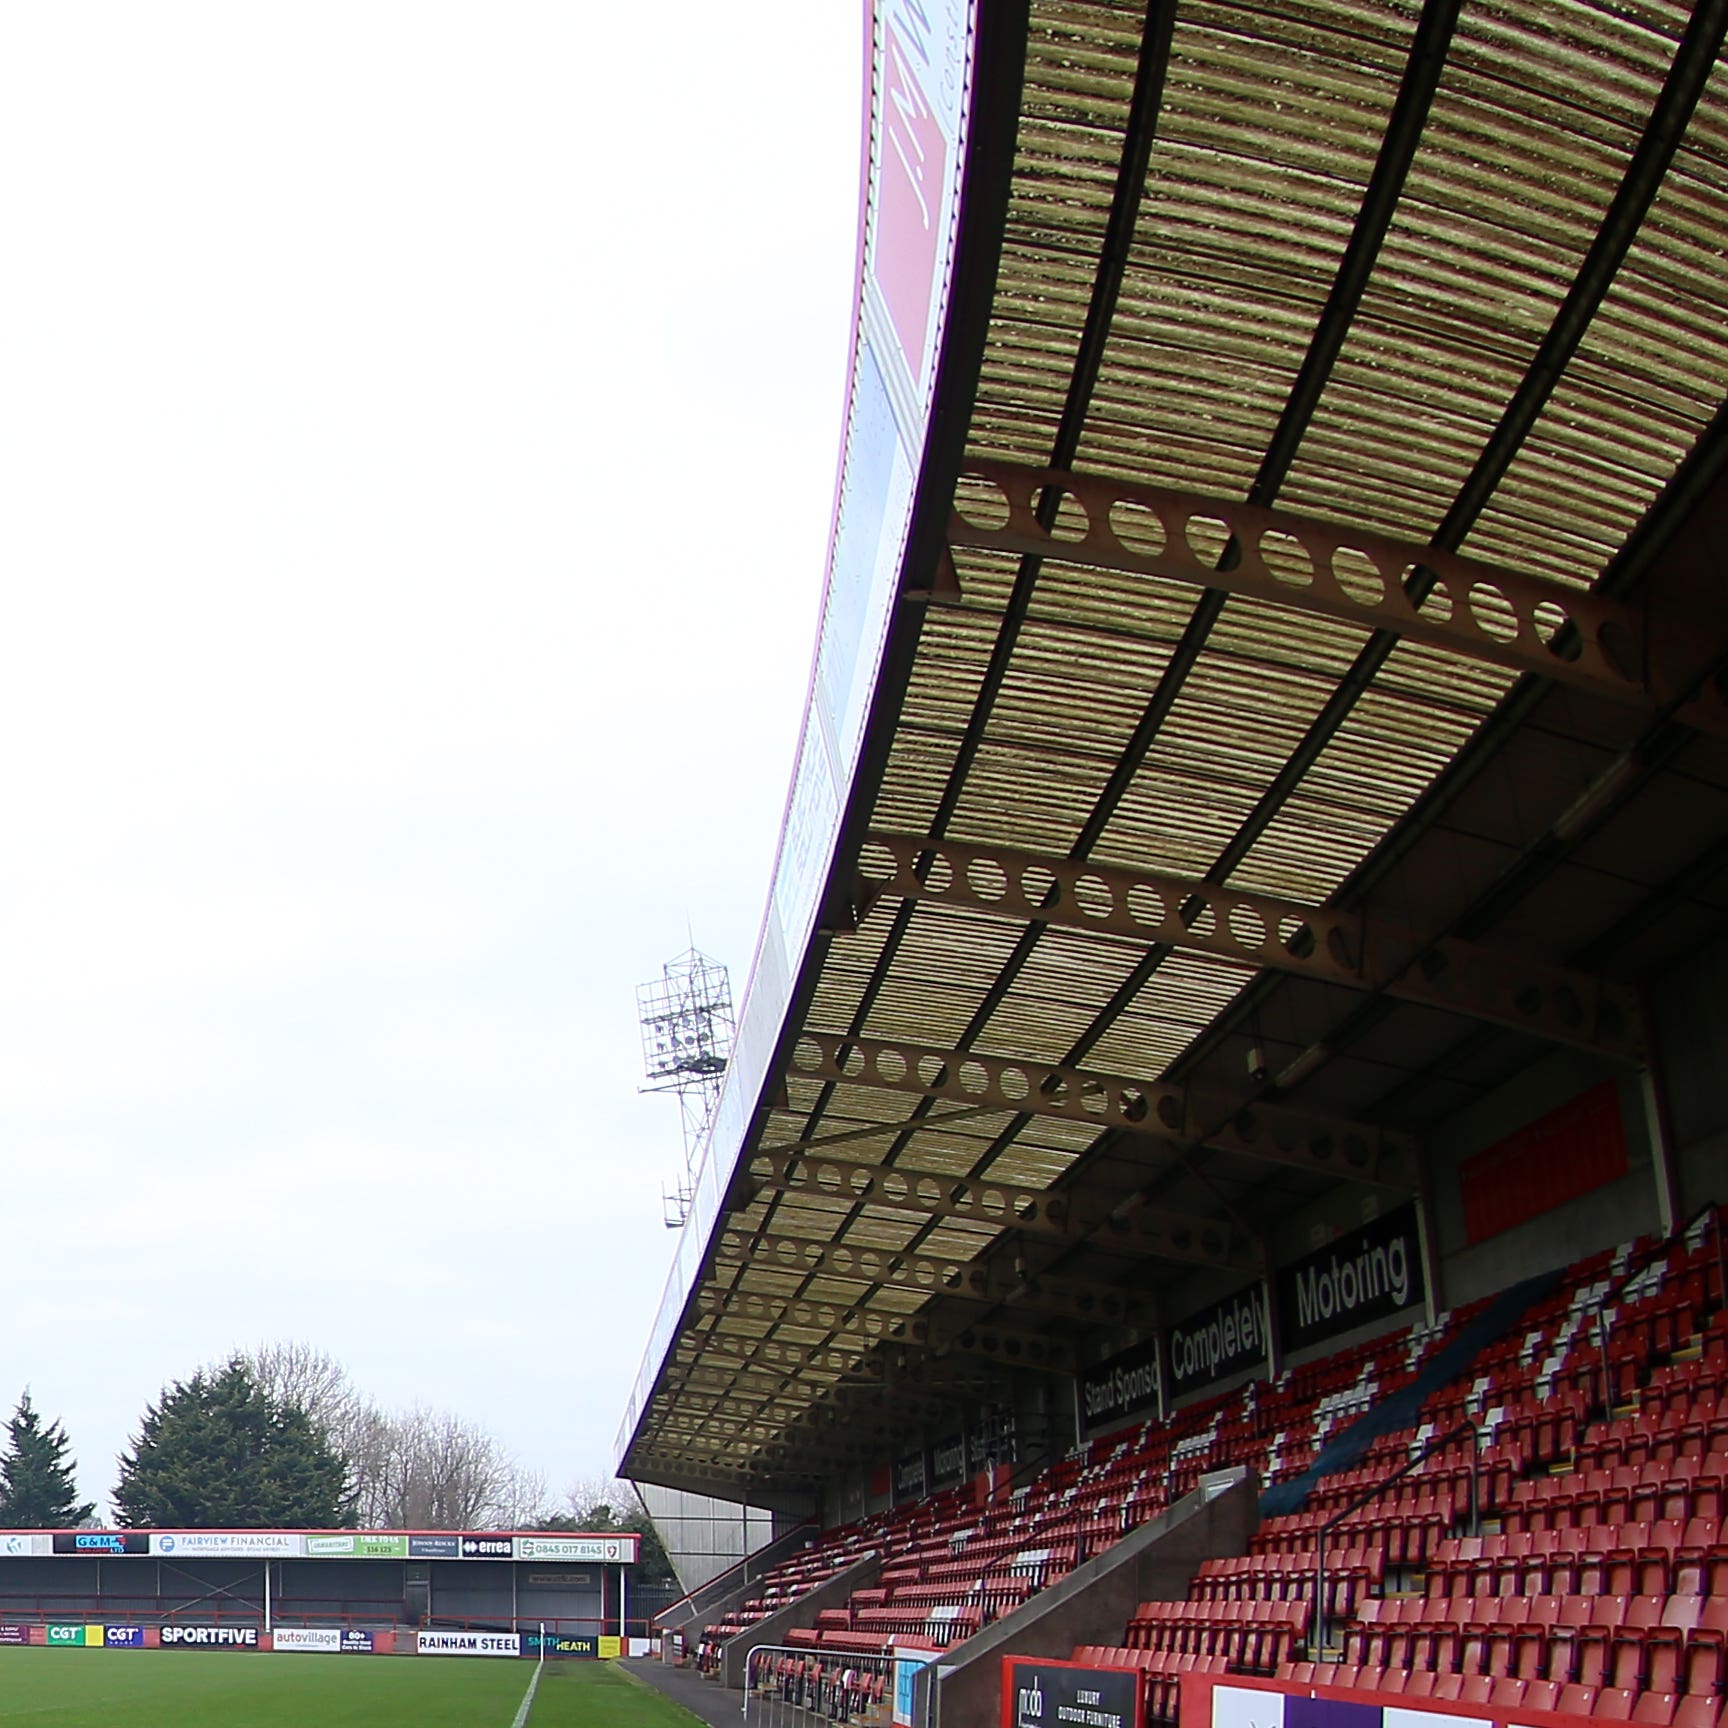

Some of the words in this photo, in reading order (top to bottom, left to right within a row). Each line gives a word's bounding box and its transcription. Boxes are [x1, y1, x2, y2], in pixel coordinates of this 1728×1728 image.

[1296, 1235, 1409, 1329] Motoring
[1171, 1288, 1270, 1381] Completely
[1084, 1377, 1114, 1418] Stand
[1116, 1358, 1160, 1411] Sponso
[182, 1537, 228, 1546] FAIRVIEW
[230, 1537, 289, 1546] FINANCIAL
[479, 1541, 511, 1554] errea
[535, 1545, 560, 1553] 0845
[562, 1545, 578, 1553] 017
[50, 1626, 79, 1639] CGT
[107, 1627, 136, 1641] CGT
[161, 1627, 257, 1645] SPORTFIVE
[276, 1631, 337, 1645] autovillage
[419, 1637, 477, 1649] RAINHAM
[481, 1637, 518, 1650] STEEL
[528, 1636, 559, 1647] SMTH
[556, 1641, 591, 1652] HEATH
[1057, 1706, 1085, 1724] OUTDOOR
